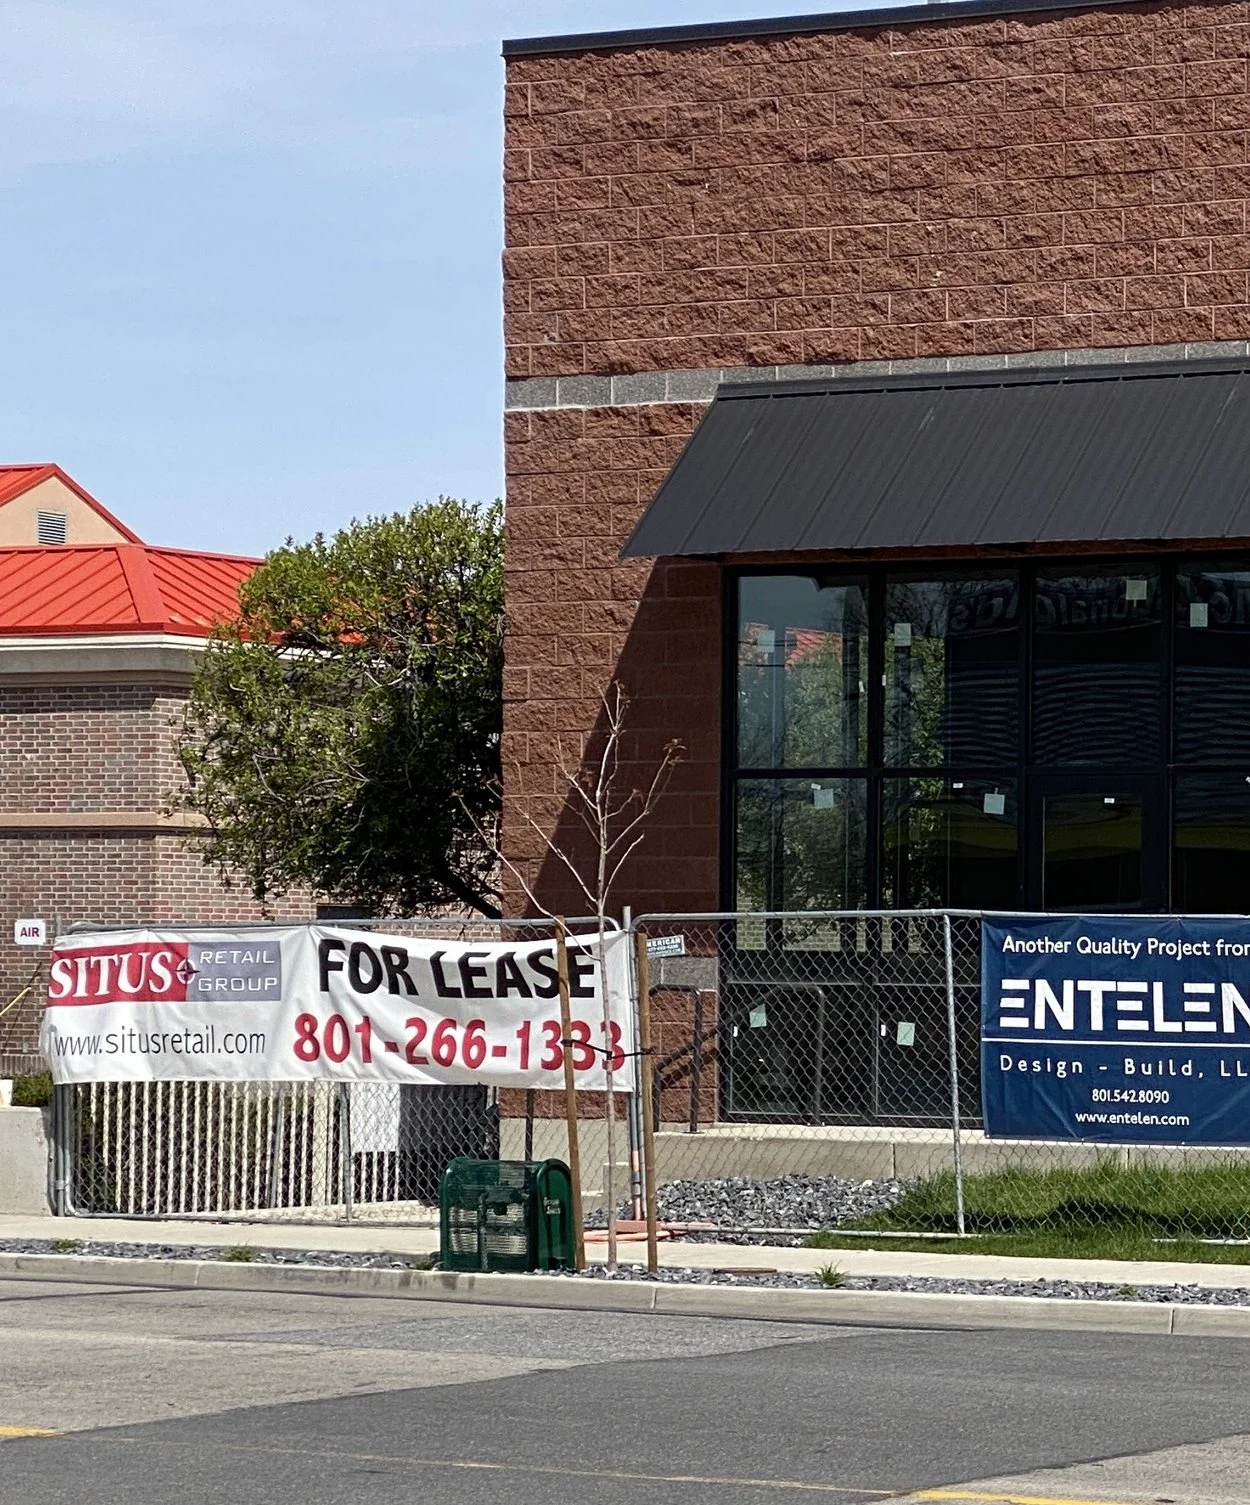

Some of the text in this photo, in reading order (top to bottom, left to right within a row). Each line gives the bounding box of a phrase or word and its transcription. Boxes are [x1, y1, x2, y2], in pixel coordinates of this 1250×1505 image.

[20, 927, 40, 938] AIR
[646, 938, 681, 947] MERICAN
[199, 950, 275, 964] RETAIL
[1002, 935, 1071, 953] Another
[1076, 936, 1142, 959] Quality
[1148, 937, 1211, 960] Project
[48, 951, 172, 999] SITUS
[318, 938, 595, 999] FOR LEASE
[198, 977, 278, 992] GROUP
[55, 1025, 265, 1056] www.situsretail.com
[293, 1013, 626, 1072] 801-266-1333
[1000, 1054, 1083, 1078] Design
[1124, 1058, 1204, 1078] Build,
[1091, 1088, 1170, 1104] 801.542.8090
[1075, 1110, 1190, 1126] www.entelen.com
